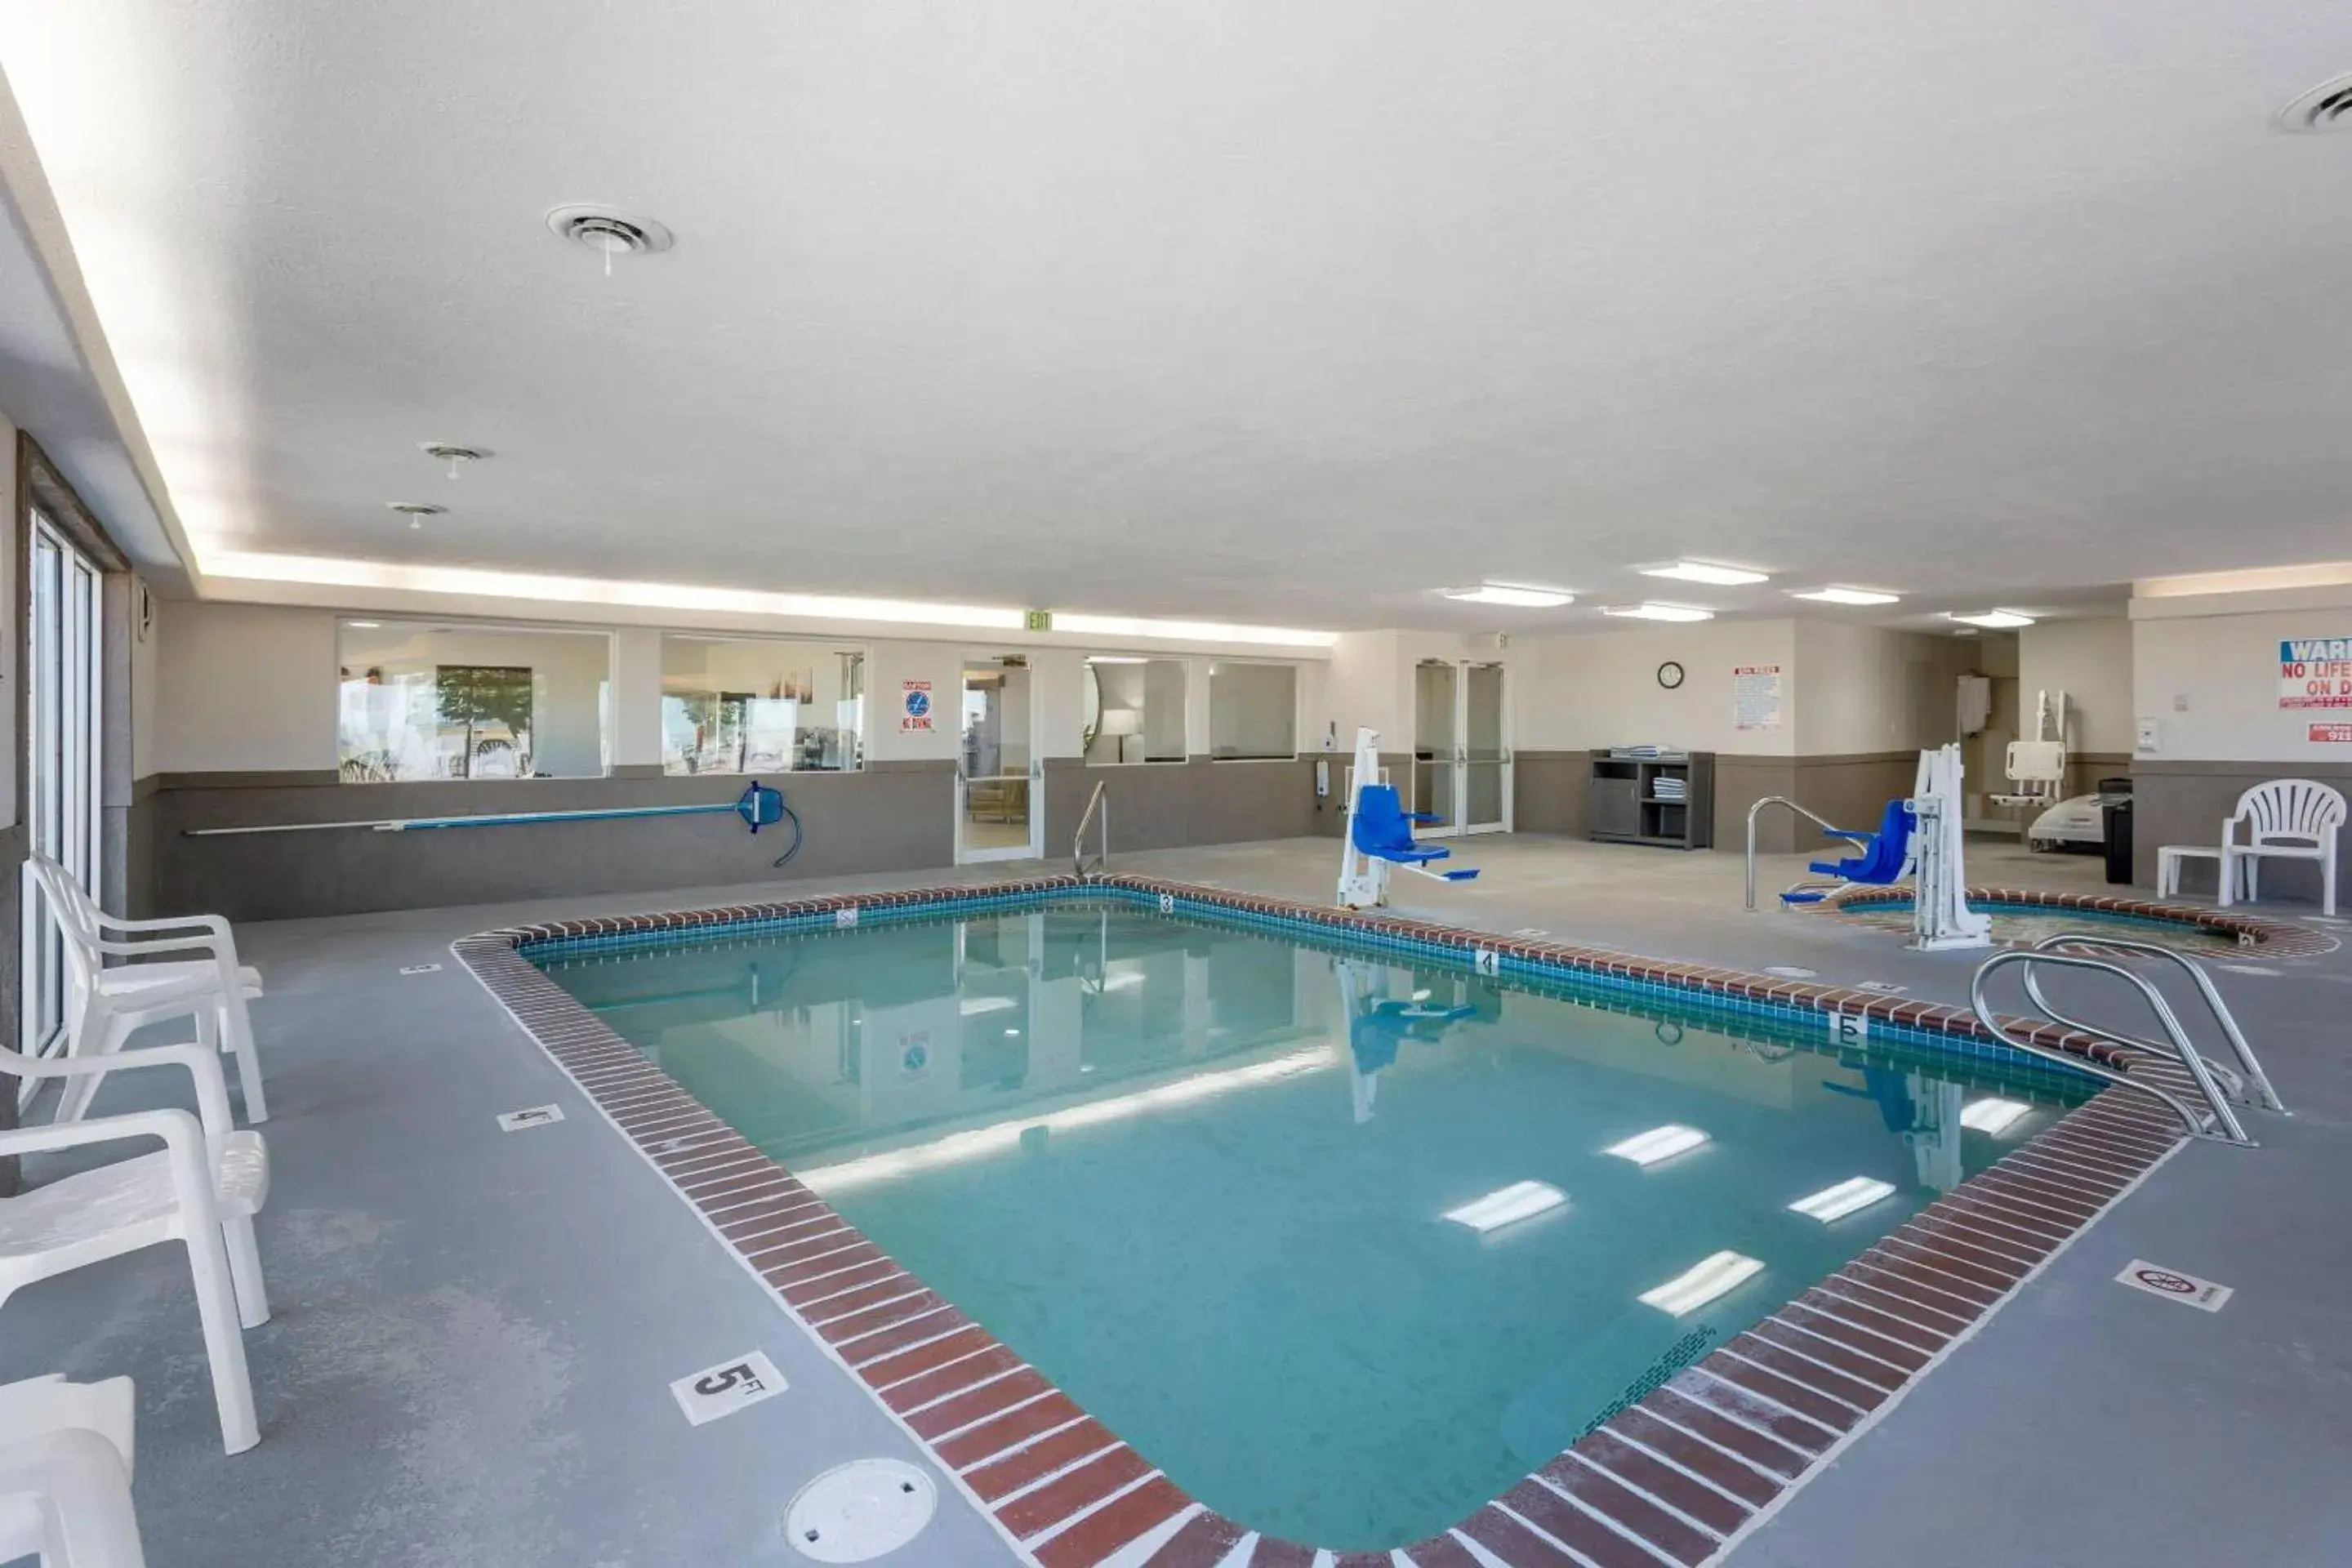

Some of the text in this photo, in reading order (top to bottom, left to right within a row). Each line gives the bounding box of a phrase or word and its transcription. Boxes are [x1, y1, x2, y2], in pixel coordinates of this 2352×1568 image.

[2283, 663, 2305, 678] NO
[2307, 679, 2330, 695] ON
[694, 1363, 755, 1396] 5
